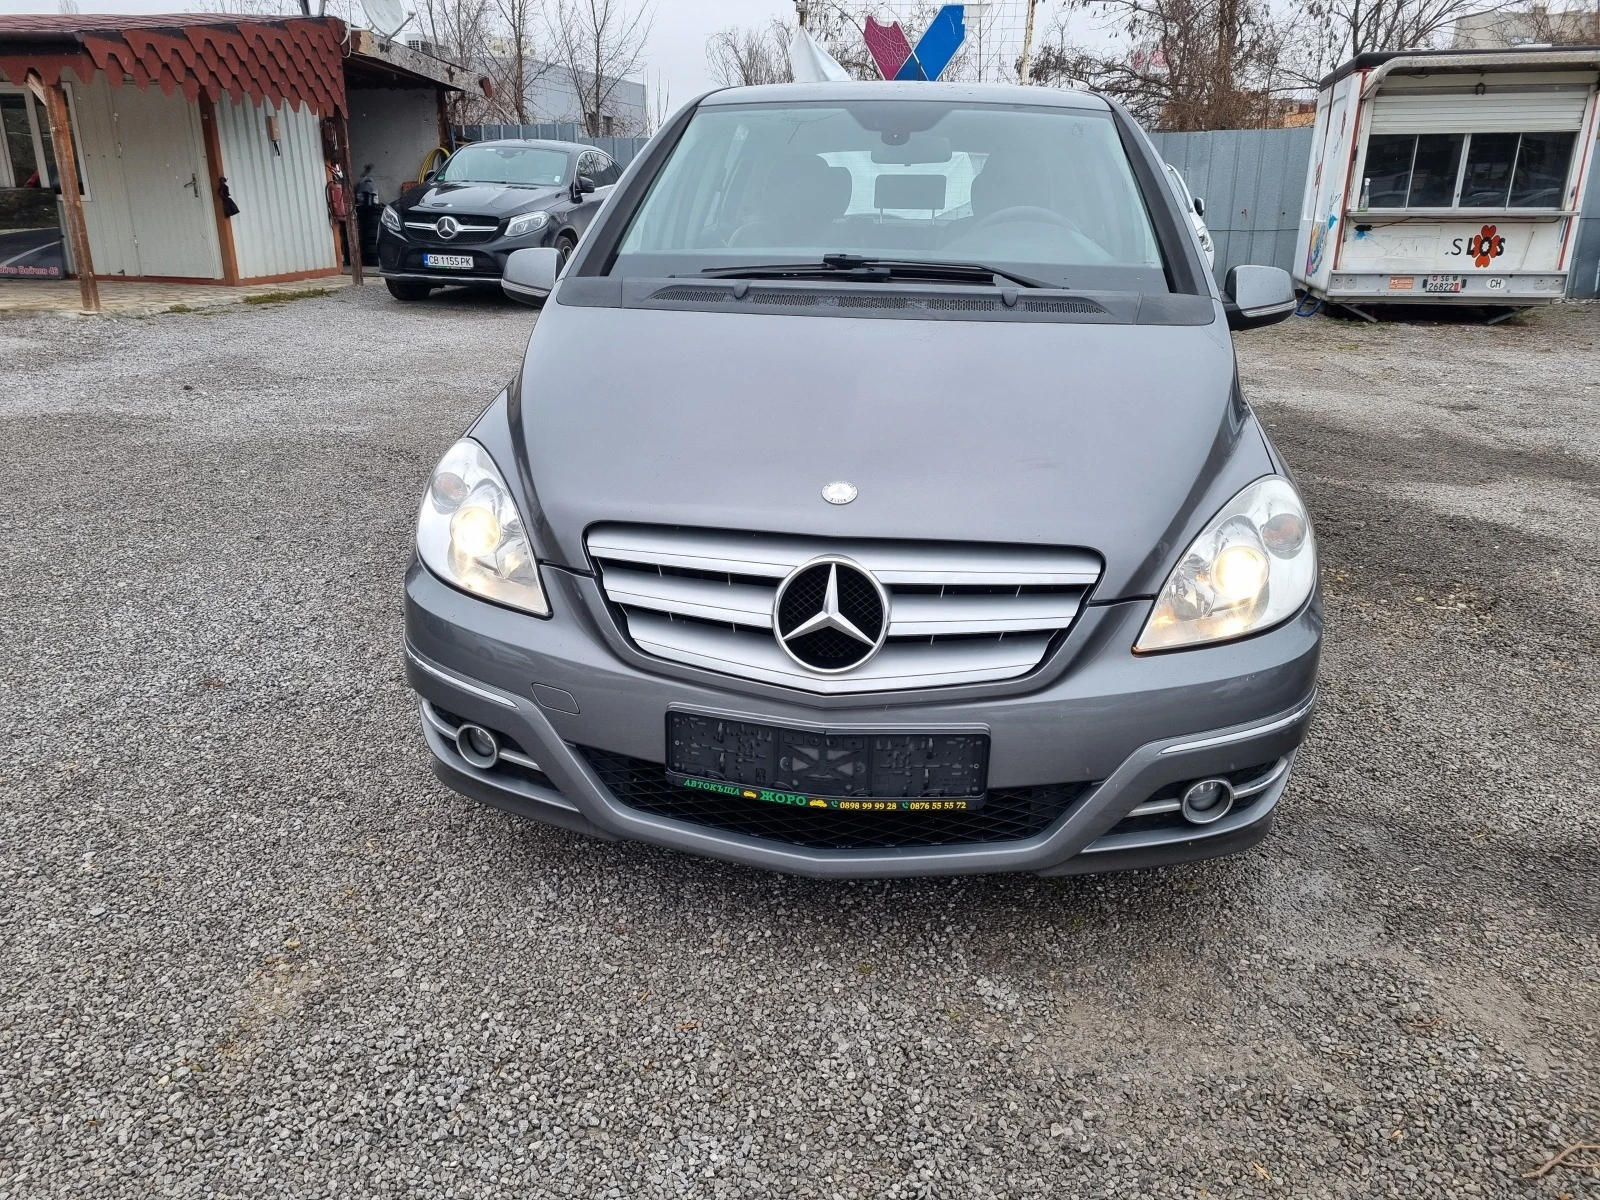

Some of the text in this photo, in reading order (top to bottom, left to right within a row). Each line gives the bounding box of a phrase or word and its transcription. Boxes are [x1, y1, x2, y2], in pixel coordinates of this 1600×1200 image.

[441, 257, 460, 266] 1155
[460, 257, 471, 266] PK
[1428, 282, 1453, 291] 26822
[1490, 279, 1502, 289] CH
[684, 779, 967, 811] АВТОКЪЩА ЖОРО 0898 99 99 28 0876 55 55 72
